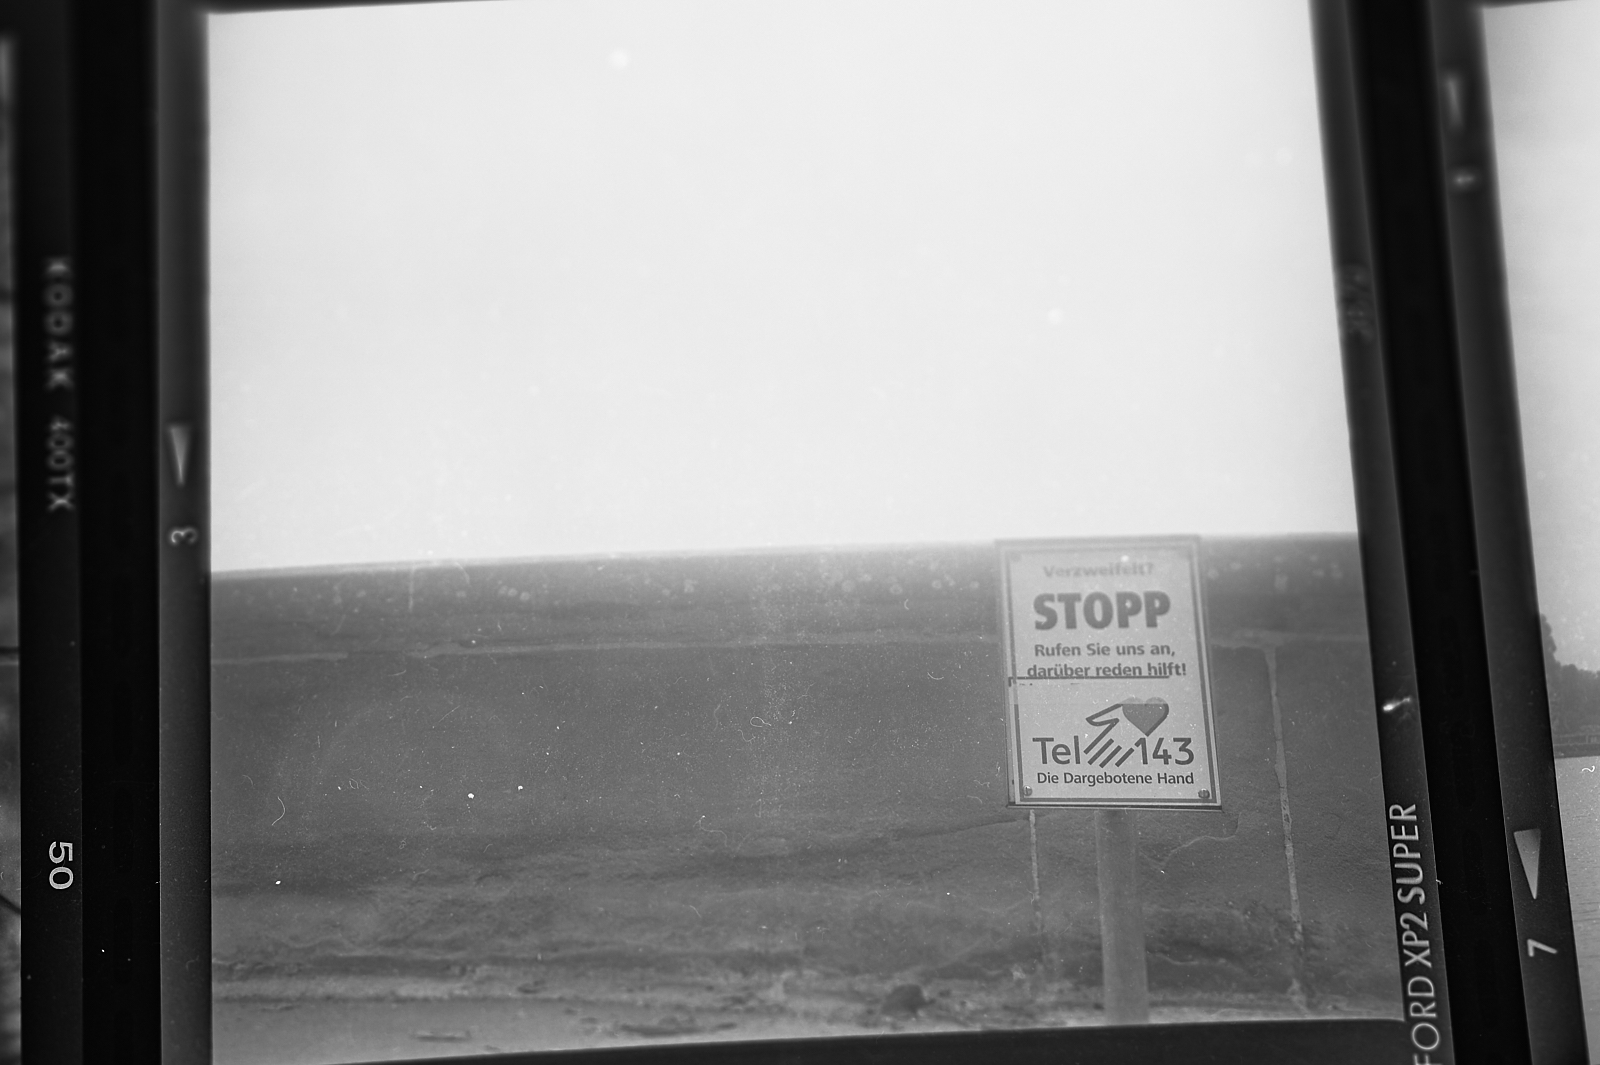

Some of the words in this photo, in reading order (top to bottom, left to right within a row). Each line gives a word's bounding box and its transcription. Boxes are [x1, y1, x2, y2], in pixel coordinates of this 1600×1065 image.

[46, 257, 73, 389] KODAK
[47, 416, 74, 511] 400TX
[171, 527, 198, 545] 3
[1043, 561, 1155, 578] Verzweifelt?
[1033, 590, 1171, 631] STOPP
[1034, 643, 1081, 657] Rufen
[1086, 642, 1111, 656] Sie
[1116, 644, 1145, 656] uns
[1150, 643, 1176, 657] an,
[1027, 664, 1090, 678] darüber
[1095, 662, 1142, 677] reden
[1147, 662, 1187, 677] hilft!
[1032, 735, 1081, 765] Tel
[1134, 737, 1195, 766] 143
[1037, 772, 1059, 784] Die
[1063, 772, 1153, 787] Dargebotene
[1157, 772, 1194, 785] Hand
[48, 841, 74, 890] 50
[1389, 803, 1426, 905] SUPER
[1400, 911, 1433, 968] XP2
[1527, 938, 1558, 957] 7
